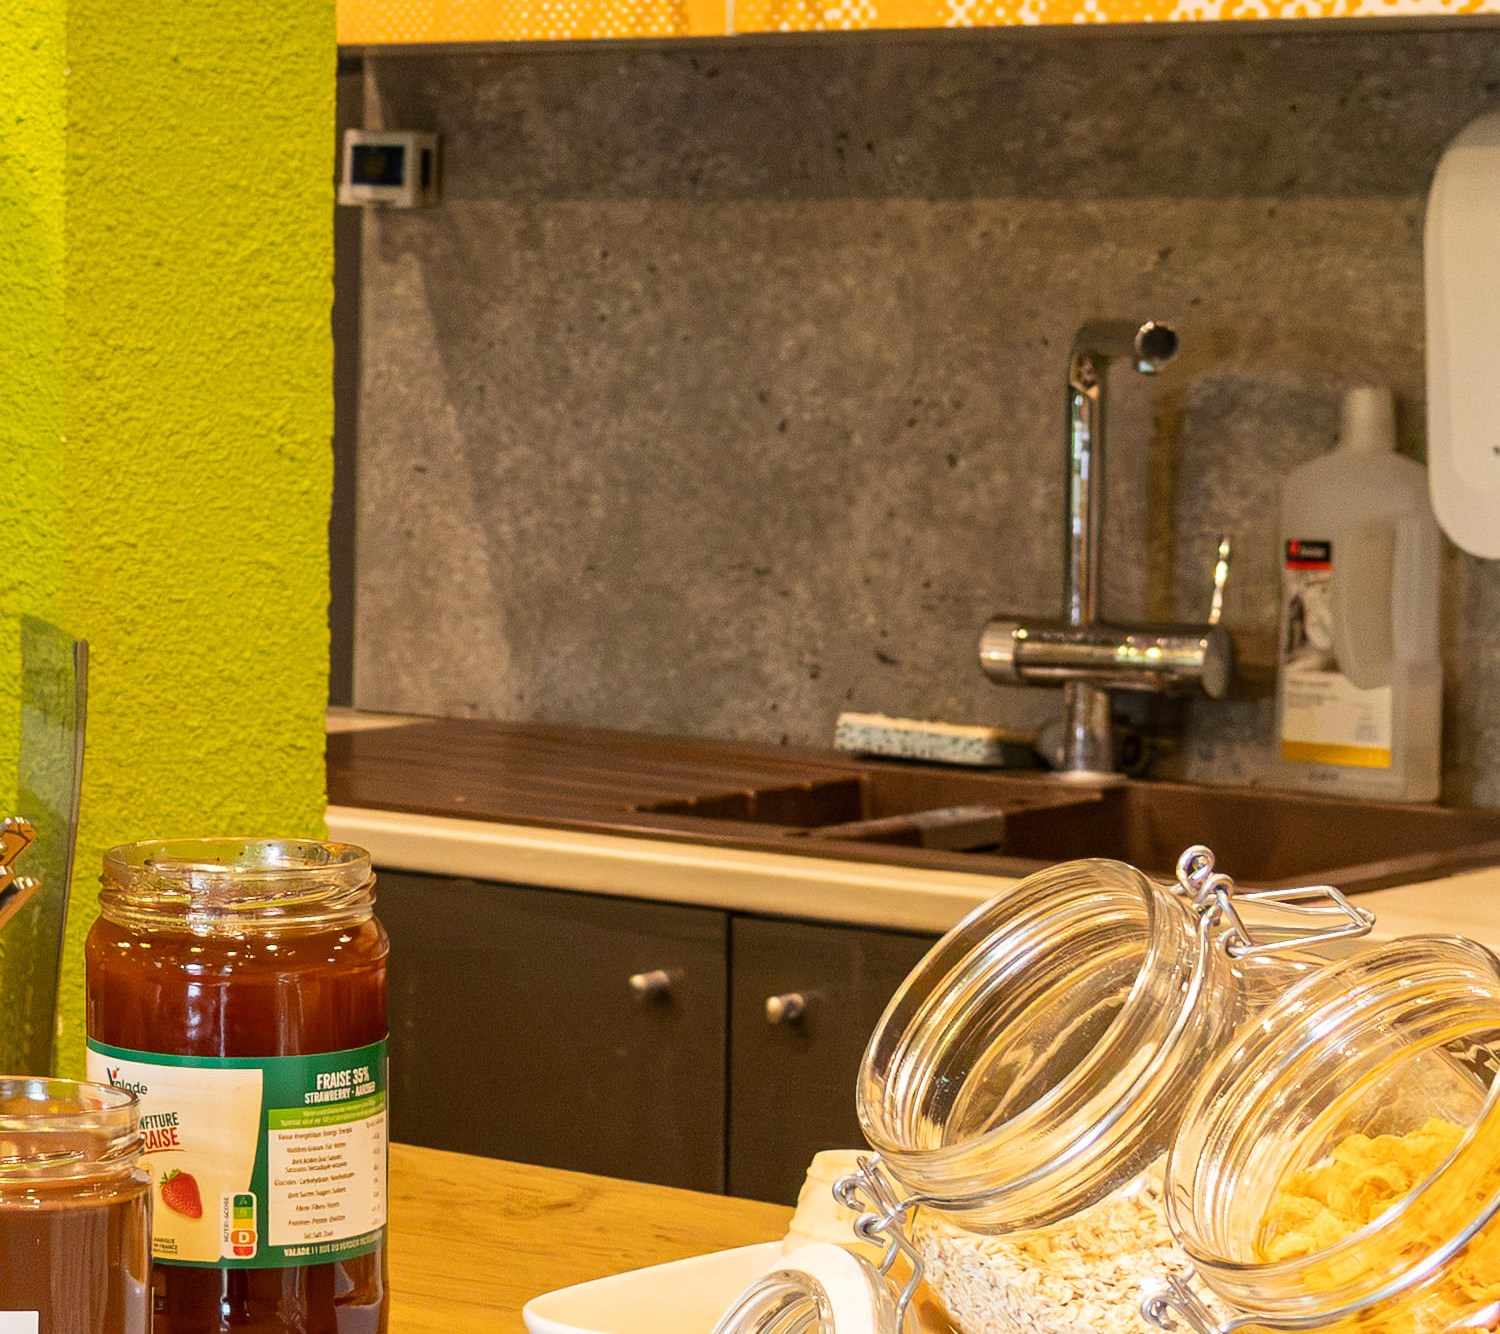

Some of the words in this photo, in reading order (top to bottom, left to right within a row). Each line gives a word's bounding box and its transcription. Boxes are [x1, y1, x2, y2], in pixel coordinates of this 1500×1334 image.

[316, 1069, 352, 1091] FRAISE
[352, 1065, 370, 1085] 35%
[140, 1112, 180, 1130] NFITURE
[140, 1127, 181, 1149] RAISE
[238, 1231, 250, 1244] D
